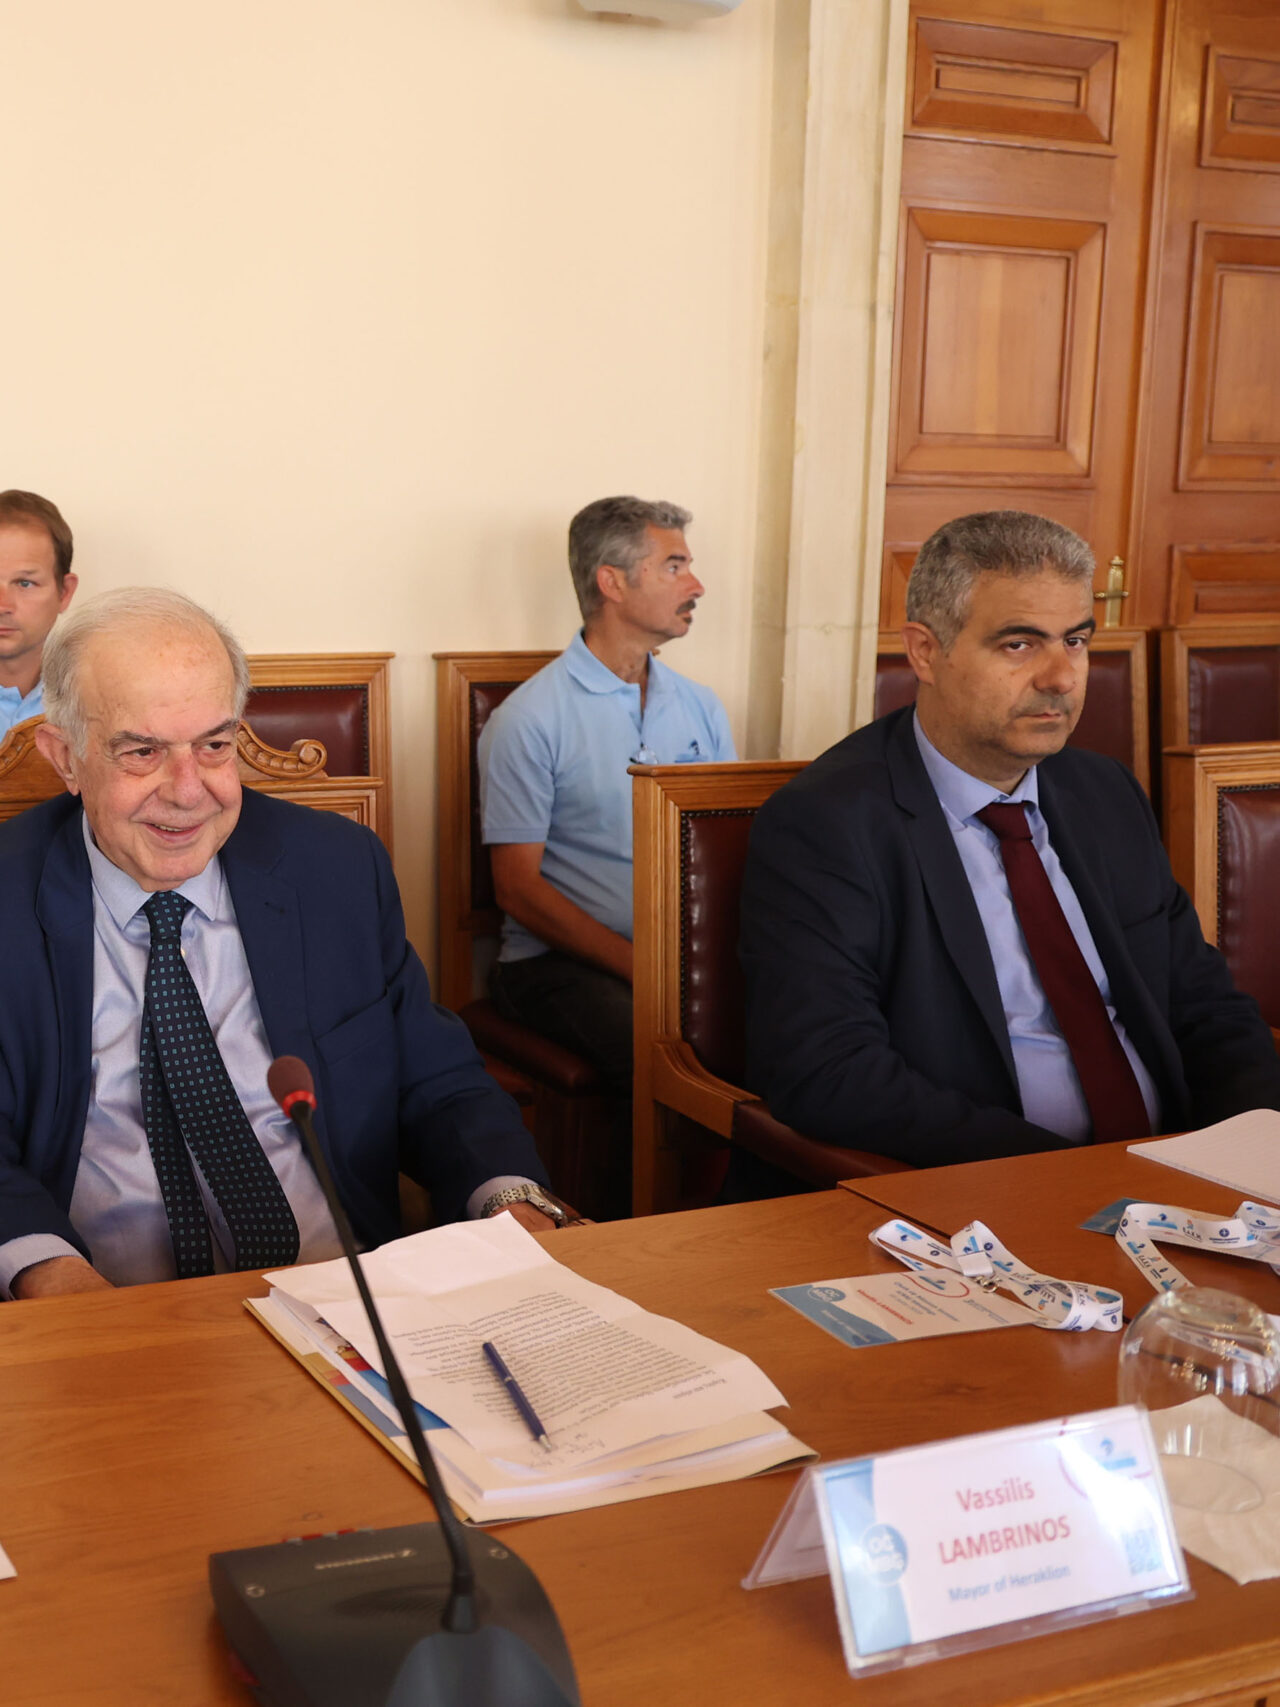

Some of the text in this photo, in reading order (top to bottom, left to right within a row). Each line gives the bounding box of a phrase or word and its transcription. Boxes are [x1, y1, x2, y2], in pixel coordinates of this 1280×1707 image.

[955, 1478, 1035, 1512] Vassilis
[938, 1515, 1071, 1565] LAMBRINOS
[948, 1564, 1071, 1602] Mayor of Heraklion
